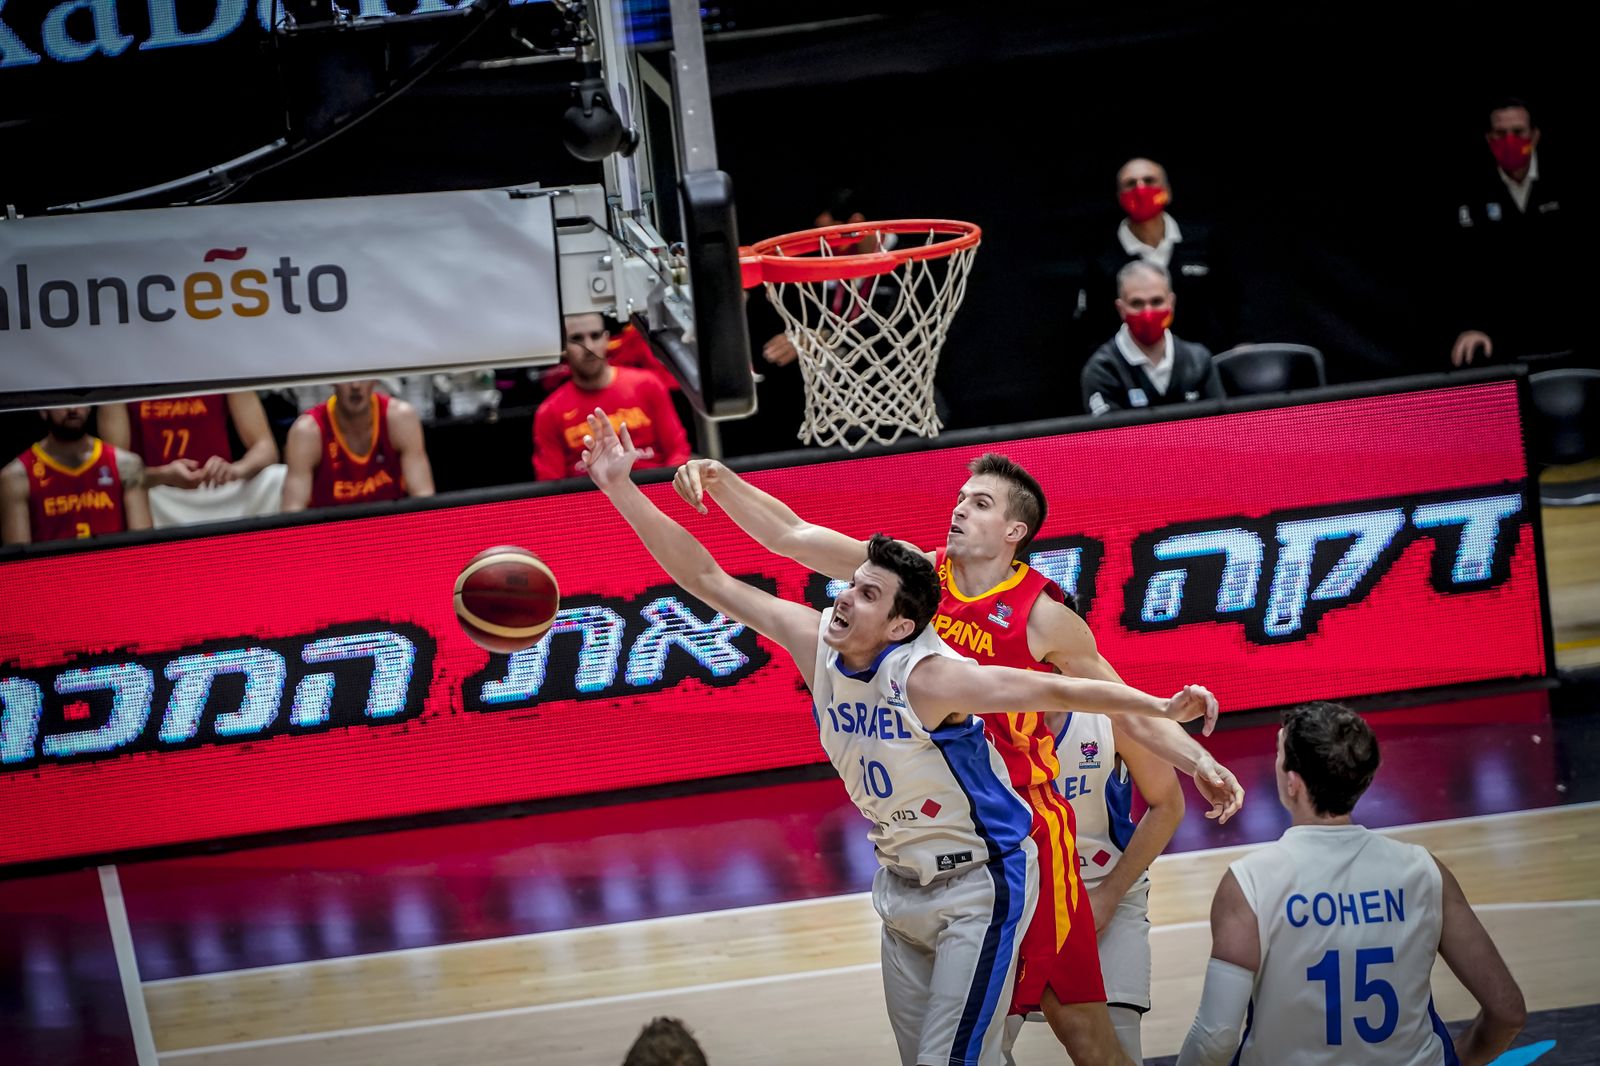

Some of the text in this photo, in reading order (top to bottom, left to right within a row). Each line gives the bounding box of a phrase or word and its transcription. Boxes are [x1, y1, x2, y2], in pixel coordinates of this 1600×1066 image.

[1141, 494, 1522, 636] דקה
[480, 597, 749, 702] את
[932, 614, 996, 657] PAÑA
[827, 702, 912, 740] ISRAEL
[859, 755, 893, 799] 10
[1286, 888, 1405, 928] COHEN
[1306, 946, 1399, 1046] 15
